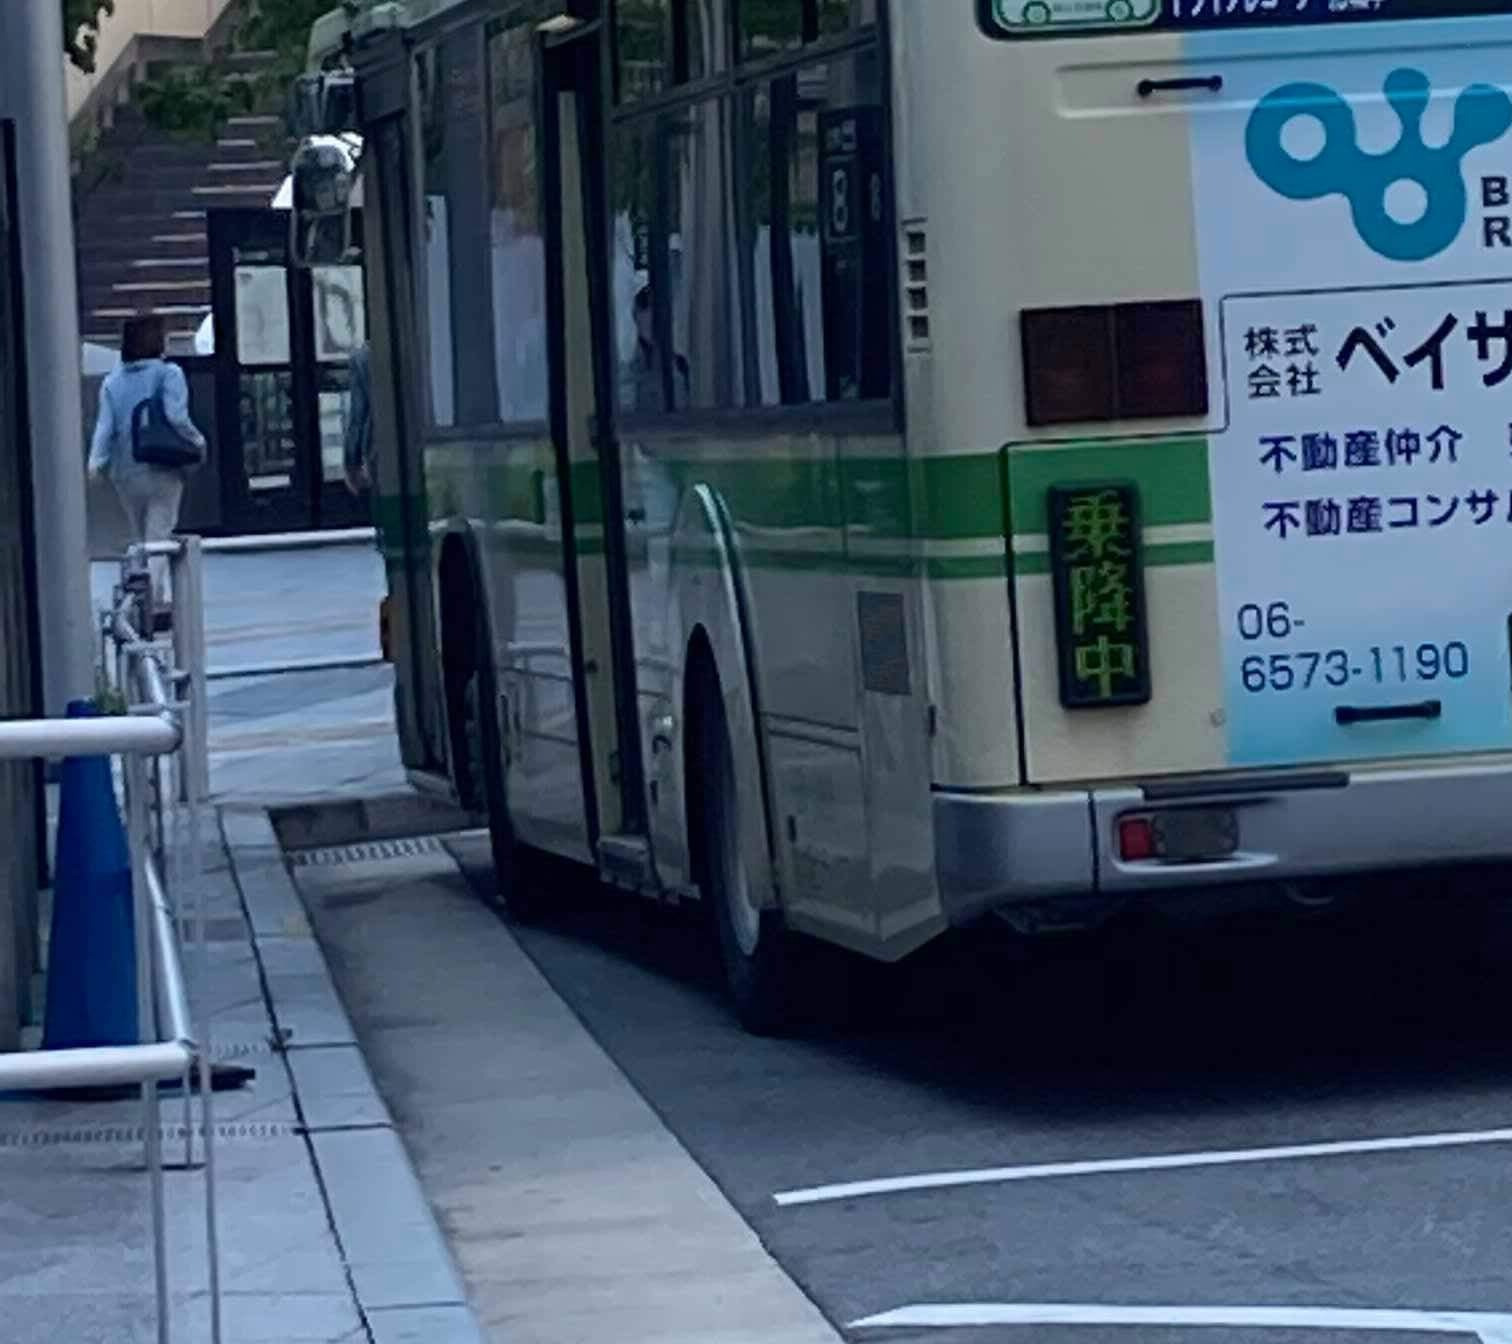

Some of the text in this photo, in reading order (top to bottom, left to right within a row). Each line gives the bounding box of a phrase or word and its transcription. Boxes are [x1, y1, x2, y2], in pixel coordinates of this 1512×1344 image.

[1243, 325, 1320, 358] 株式
[1247, 363, 1322, 399] 会社
[1258, 425, 1464, 472] 不動産仲介
[1062, 489, 1136, 698] 乗降中
[1237, 601, 1306, 640] 06-
[1241, 640, 1470, 693] 6573-1190
